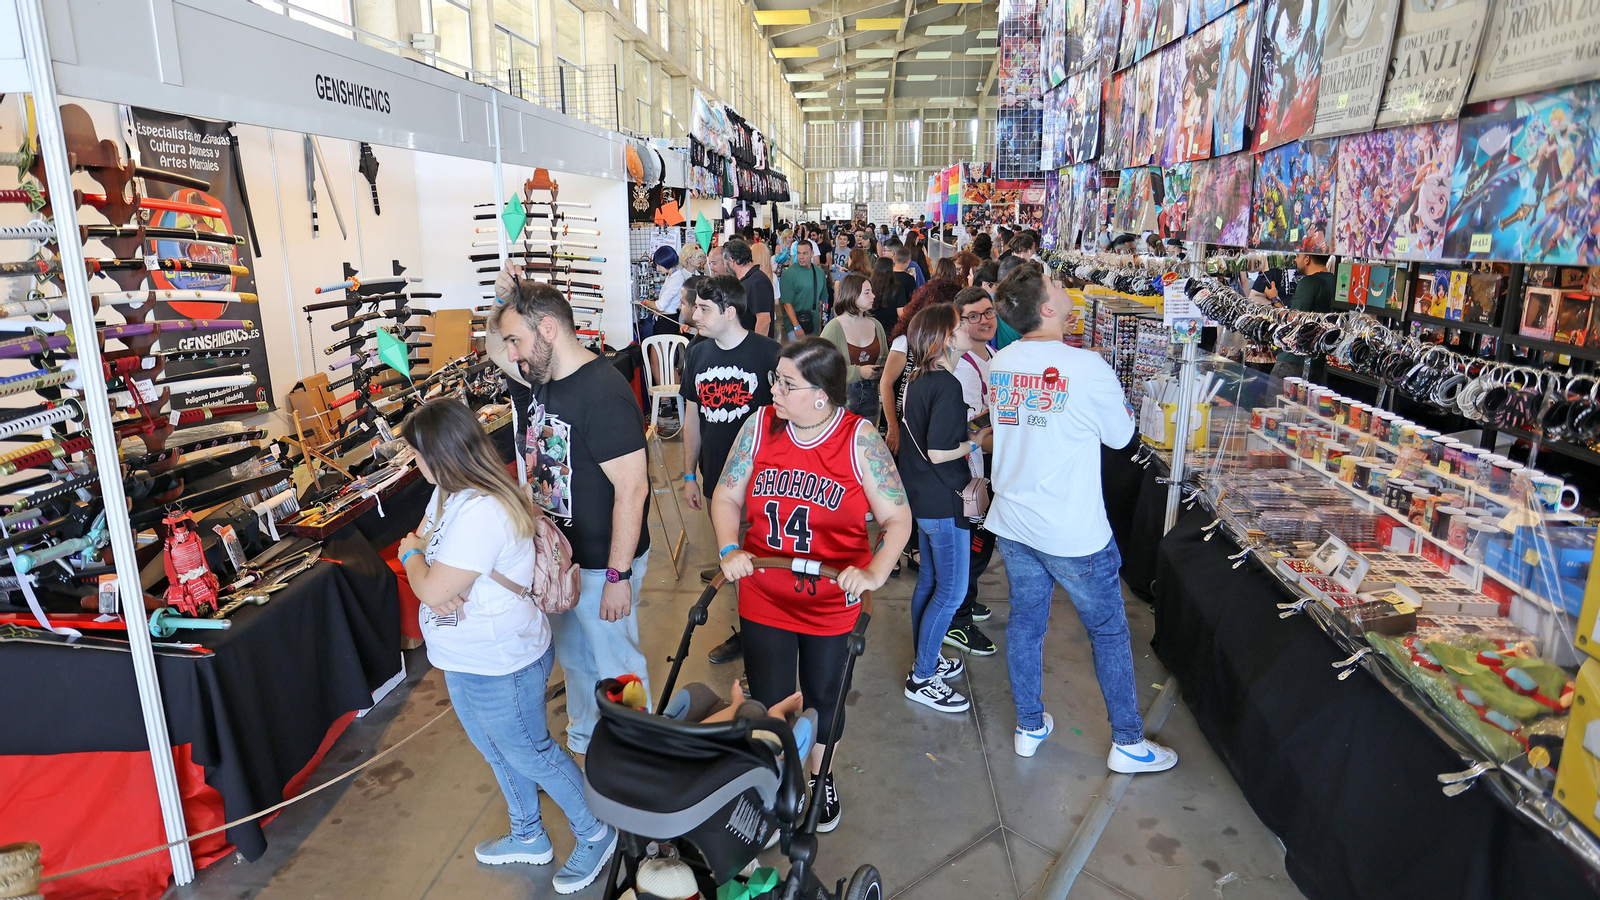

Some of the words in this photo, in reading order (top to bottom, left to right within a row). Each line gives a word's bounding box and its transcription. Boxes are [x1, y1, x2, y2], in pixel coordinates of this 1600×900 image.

[1404, 34, 1425, 52] ONLY
[1425, 28, 1452, 46] ALIVE
[1321, 60, 1339, 75] DEAD
[1342, 56, 1352, 69] OR
[1355, 48, 1380, 65] ALIVE
[1385, 40, 1464, 82] SANJI
[315, 73, 391, 115] GENSHIKENCS
[149, 139, 186, 155] Cultura
[159, 155, 187, 169] Artes
[189, 158, 220, 172] Marciales
[178, 328, 261, 351] GENSHIKENCS.ES
[990, 372, 1011, 387] NEW
[1027, 415, 1047, 427] 主人公
[752, 468, 846, 512] SHOHOKU
[764, 499, 813, 554] 14
